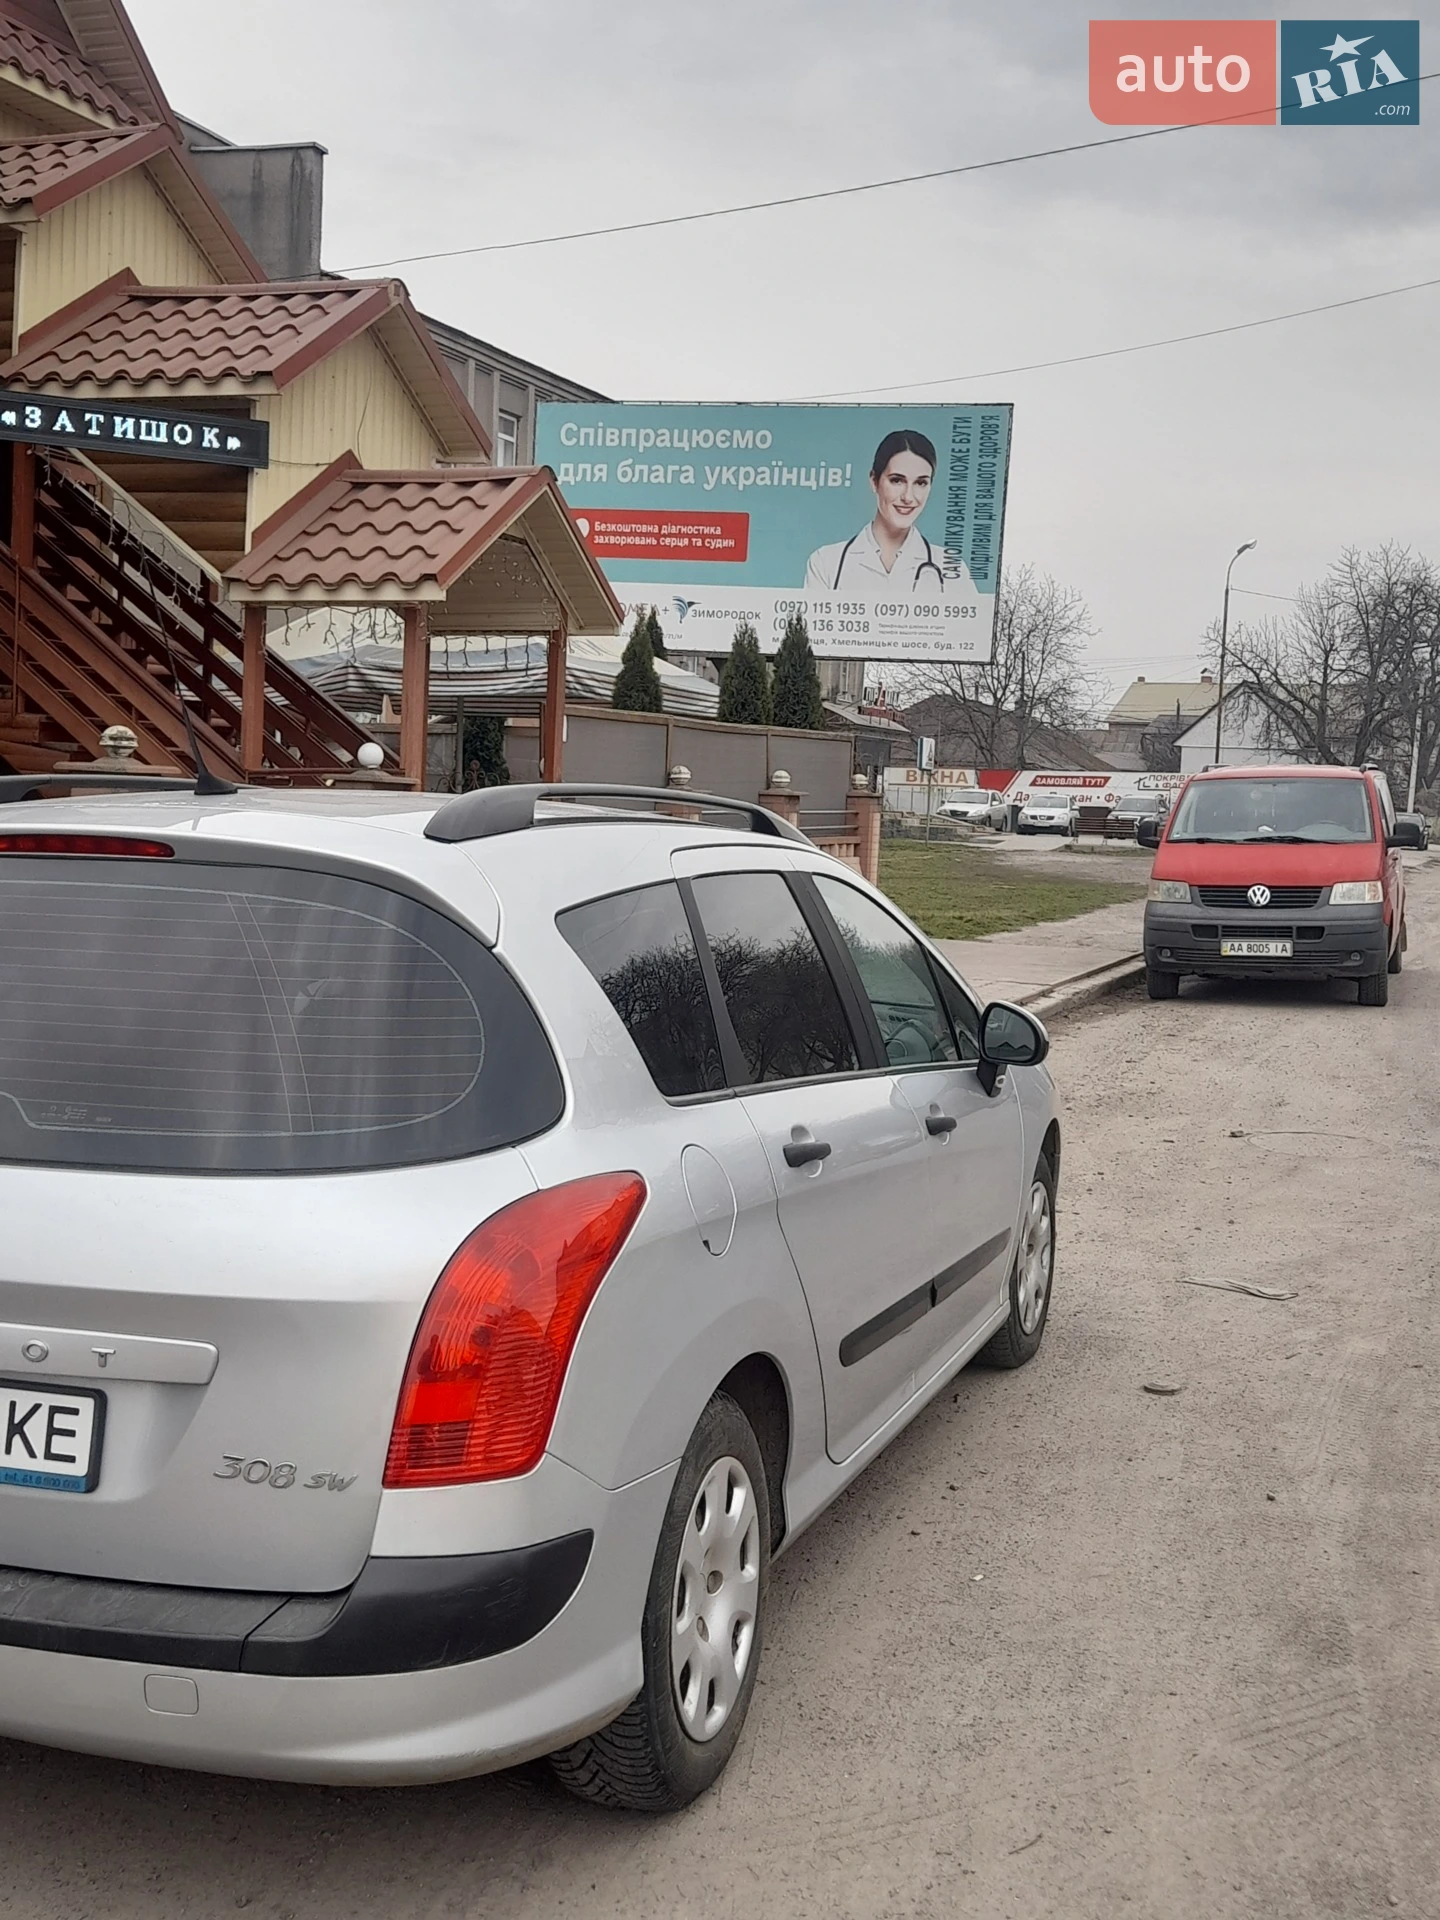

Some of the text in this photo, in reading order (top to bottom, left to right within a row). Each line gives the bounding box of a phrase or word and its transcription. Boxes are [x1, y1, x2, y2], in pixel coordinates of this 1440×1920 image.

[560, 421, 773, 453] Співпрацюємо
[557, 458, 852, 491] для блага українців!
[975, 461, 997, 499] ВАШОГО
[942, 416, 972, 579] САМОЛІКУВАННЯ МОЖЕ БУТИ
[974, 502, 997, 521] ДЛЯ
[594, 521, 721, 535] Безкоштовна діагностика
[593, 535, 735, 549] захворювань серця та судин
[969, 523, 993, 580] ШКІДЛИВИМ
[691, 609, 761, 620] ЗИМОРОДОК
[774, 600, 977, 618] (097) 115 1935 (097) 090 5993
[773, 617, 808, 631] (0)
[812, 620, 834, 632] 136
[838, 620, 870, 633] 3038
[831, 638, 899, 648] Хмельницьке
[902, 641, 931, 649] шосе,
[959, 642, 975, 650] 122
[905, 769, 969, 784] ВІКНА
[1035, 777, 1083, 785] ЗАМОВЛЯЙ
[1229, 943, 1243, 953] AA
[1246, 943, 1270, 954] 8005
[5, 1400, 80, 1464] KE
[213, 1453, 297, 1490] 308
